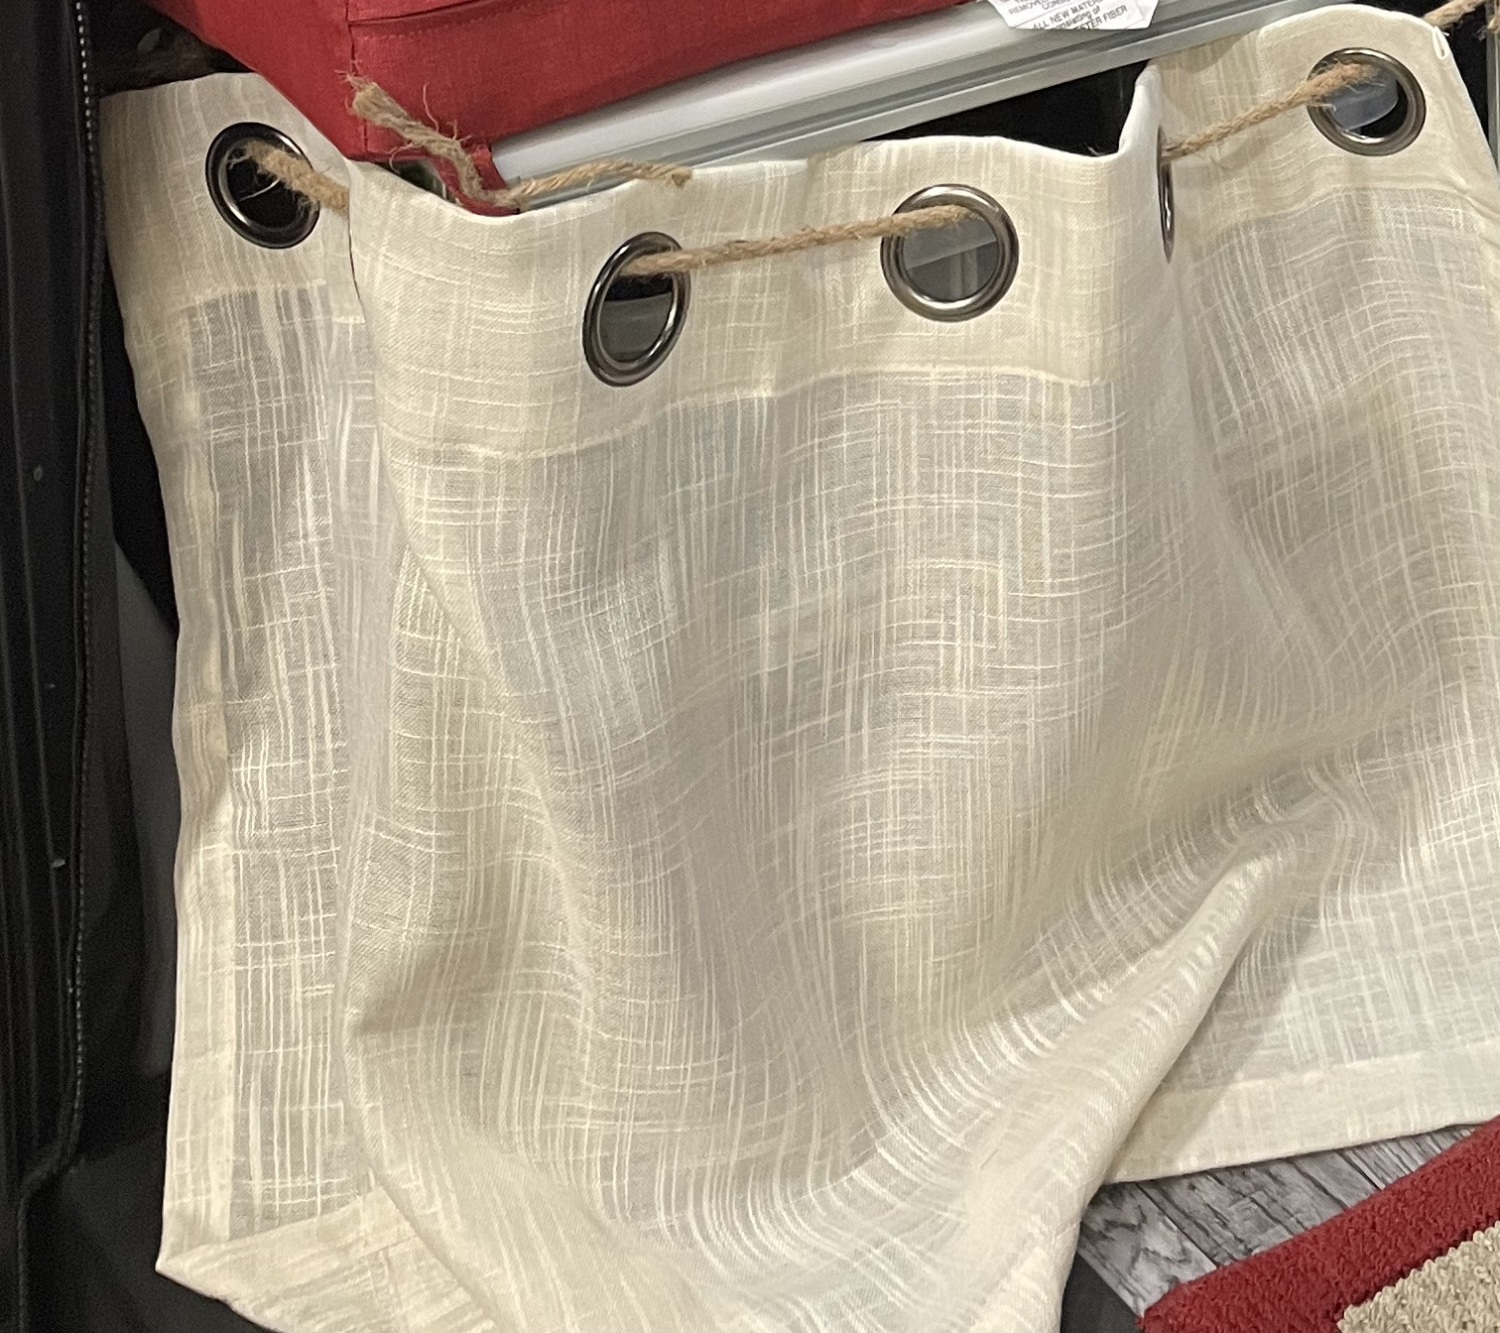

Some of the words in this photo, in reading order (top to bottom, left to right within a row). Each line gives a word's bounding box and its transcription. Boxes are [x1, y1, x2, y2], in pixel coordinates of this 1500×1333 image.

[1033, 19, 1050, 30] ALL
[1049, 9, 1070, 25] NEW
[1103, 5, 1128, 21] FIBER
